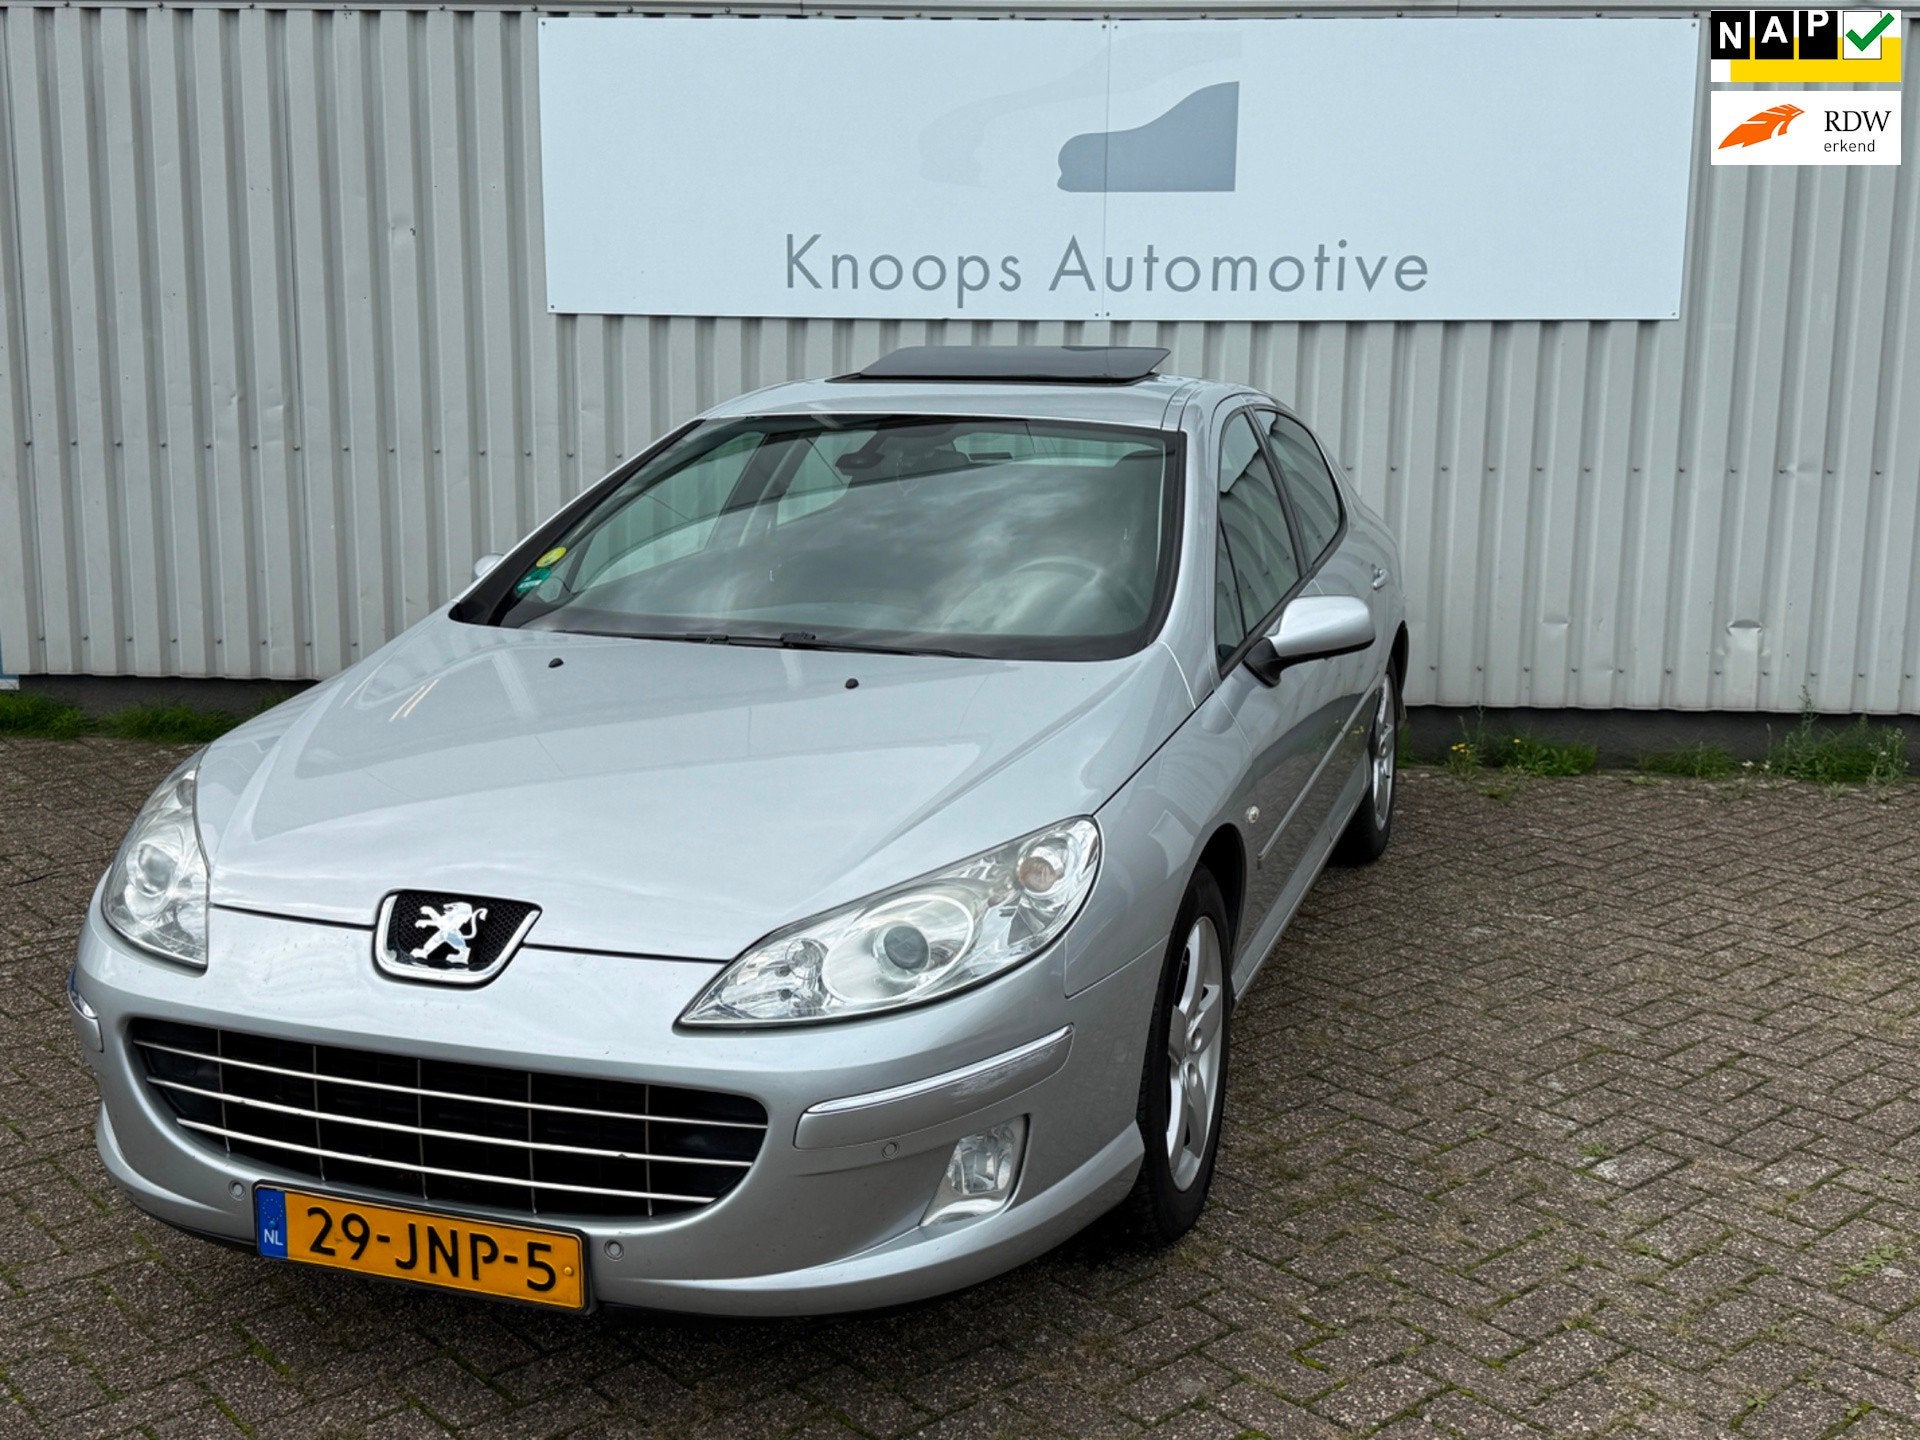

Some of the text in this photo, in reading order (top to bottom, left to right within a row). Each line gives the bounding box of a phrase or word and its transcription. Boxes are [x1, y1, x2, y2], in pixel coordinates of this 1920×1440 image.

[786, 233, 1429, 309] Knoops Automotive
[263, 1207, 557, 1292] NL 29-JNP-5
